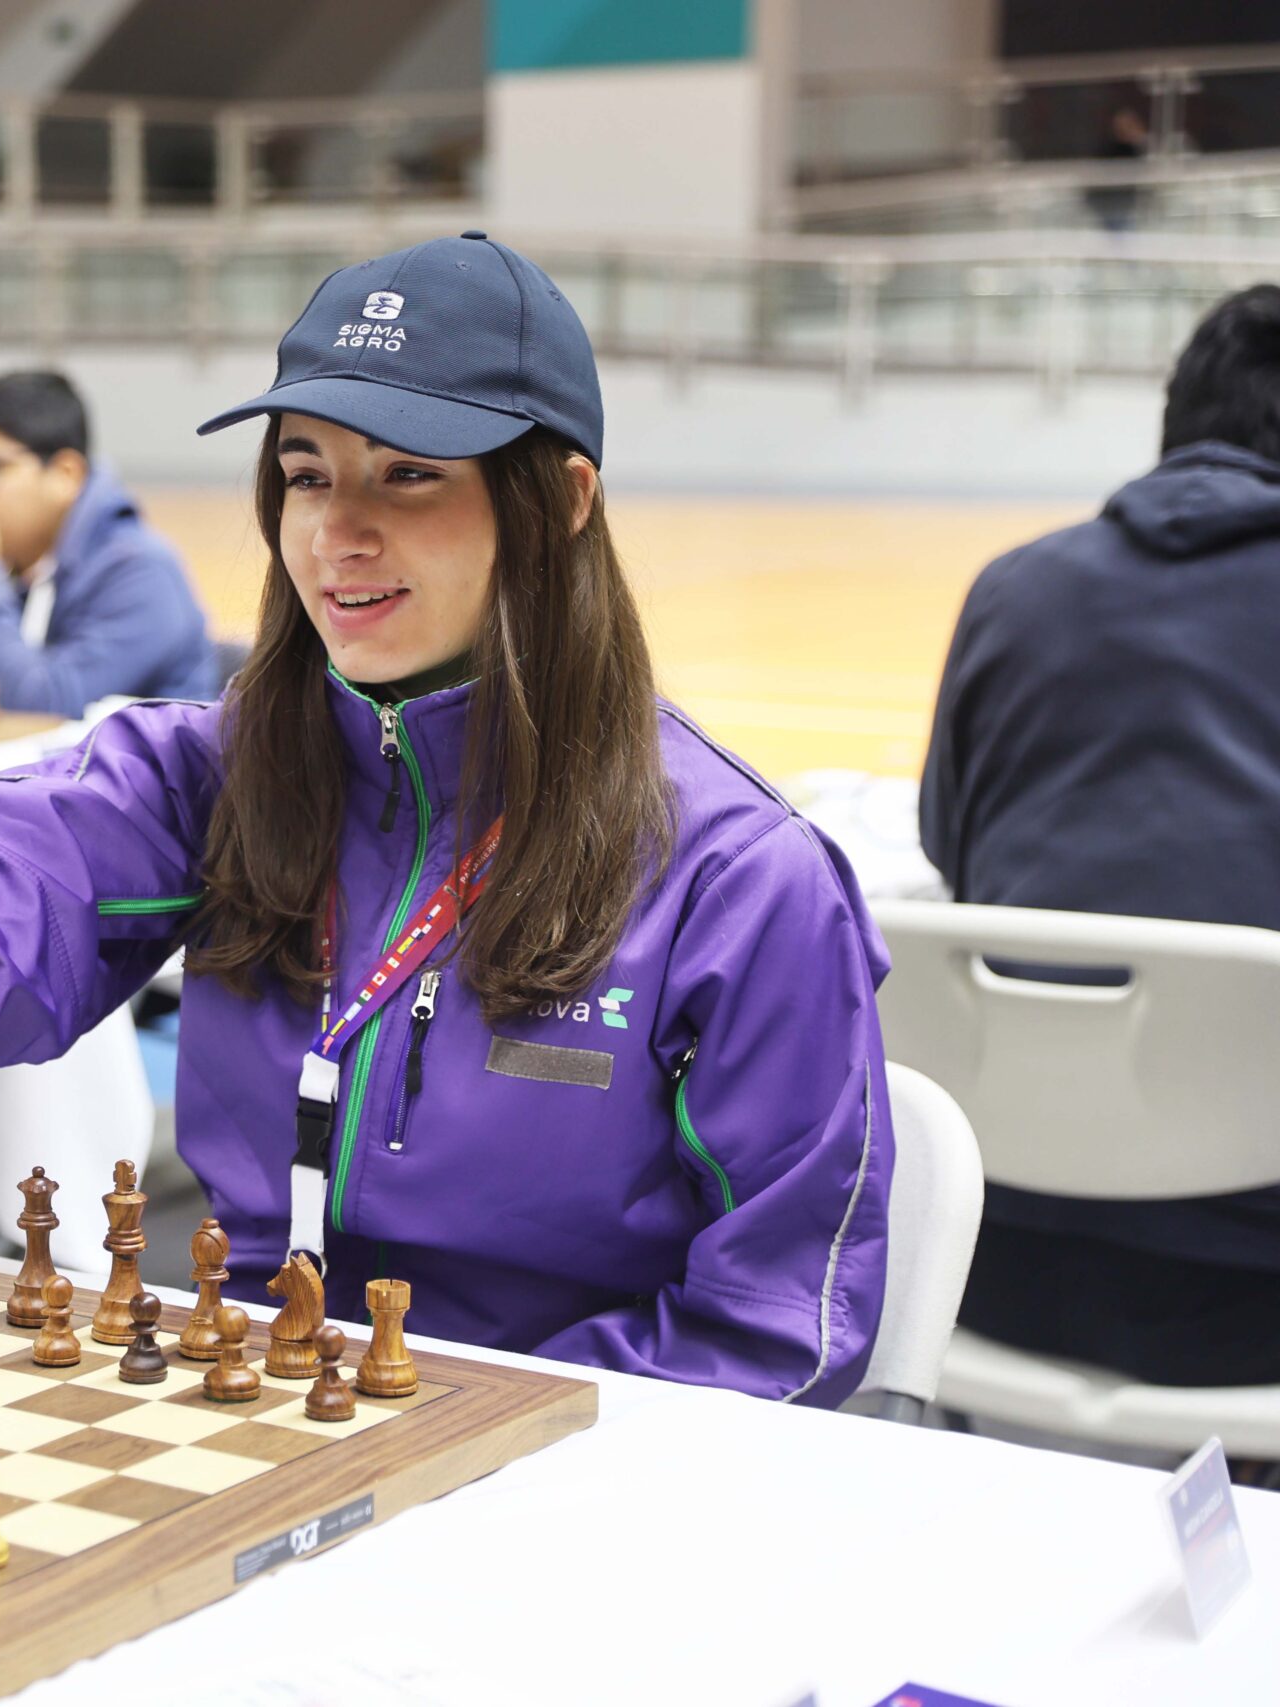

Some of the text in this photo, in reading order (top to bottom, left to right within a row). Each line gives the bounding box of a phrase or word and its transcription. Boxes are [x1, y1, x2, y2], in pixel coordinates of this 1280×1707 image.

[338, 323, 407, 340] SIGMA
[333, 336, 401, 351] AGRO
[528, 999, 591, 1022] ova
